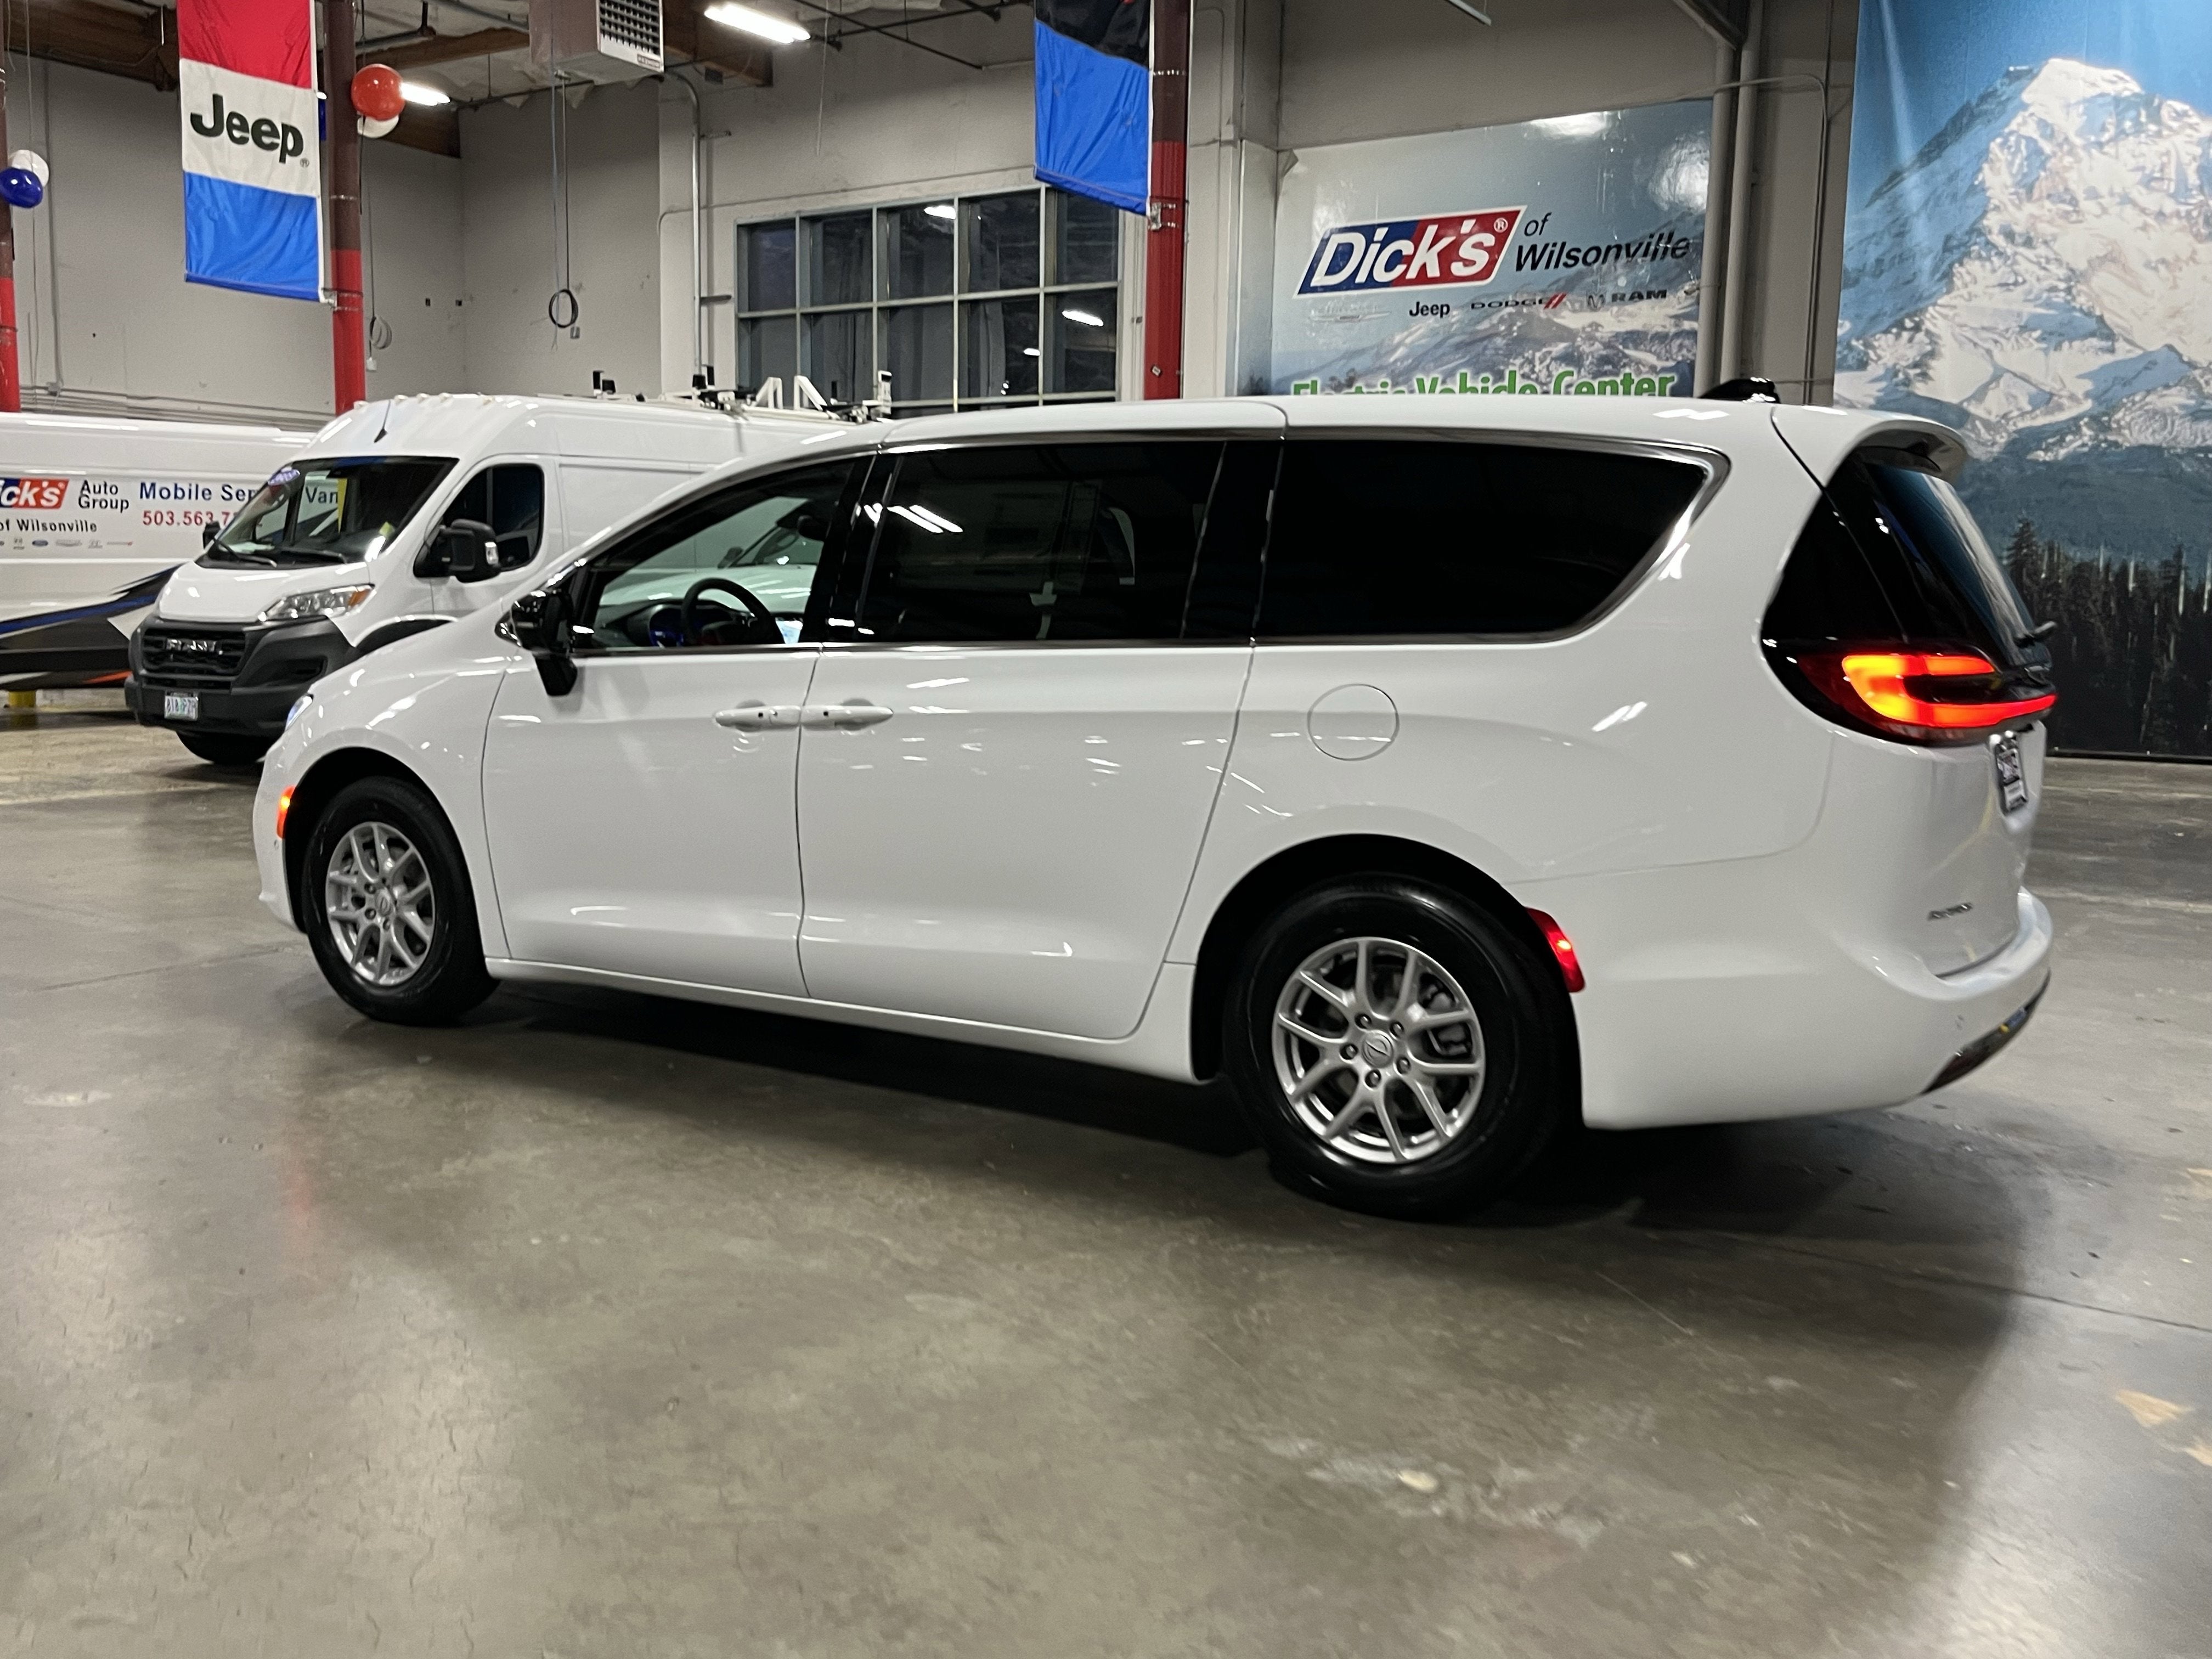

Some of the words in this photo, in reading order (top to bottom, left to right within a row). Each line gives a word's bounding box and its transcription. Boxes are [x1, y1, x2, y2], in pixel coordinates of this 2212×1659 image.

[190, 93, 304, 164] Jeep
[1524, 212, 1552, 236] of
[1515, 228, 1690, 272] Wilsonville
[1409, 301, 1451, 318] Jeep
[1611, 289, 1667, 303] RAM
[80, 479, 119, 495] Auto
[139, 482, 212, 501] Mobile
[305, 486, 338, 504] Van
[78, 494, 129, 513] Group
[16, 518, 97, 532] Wilsonville
